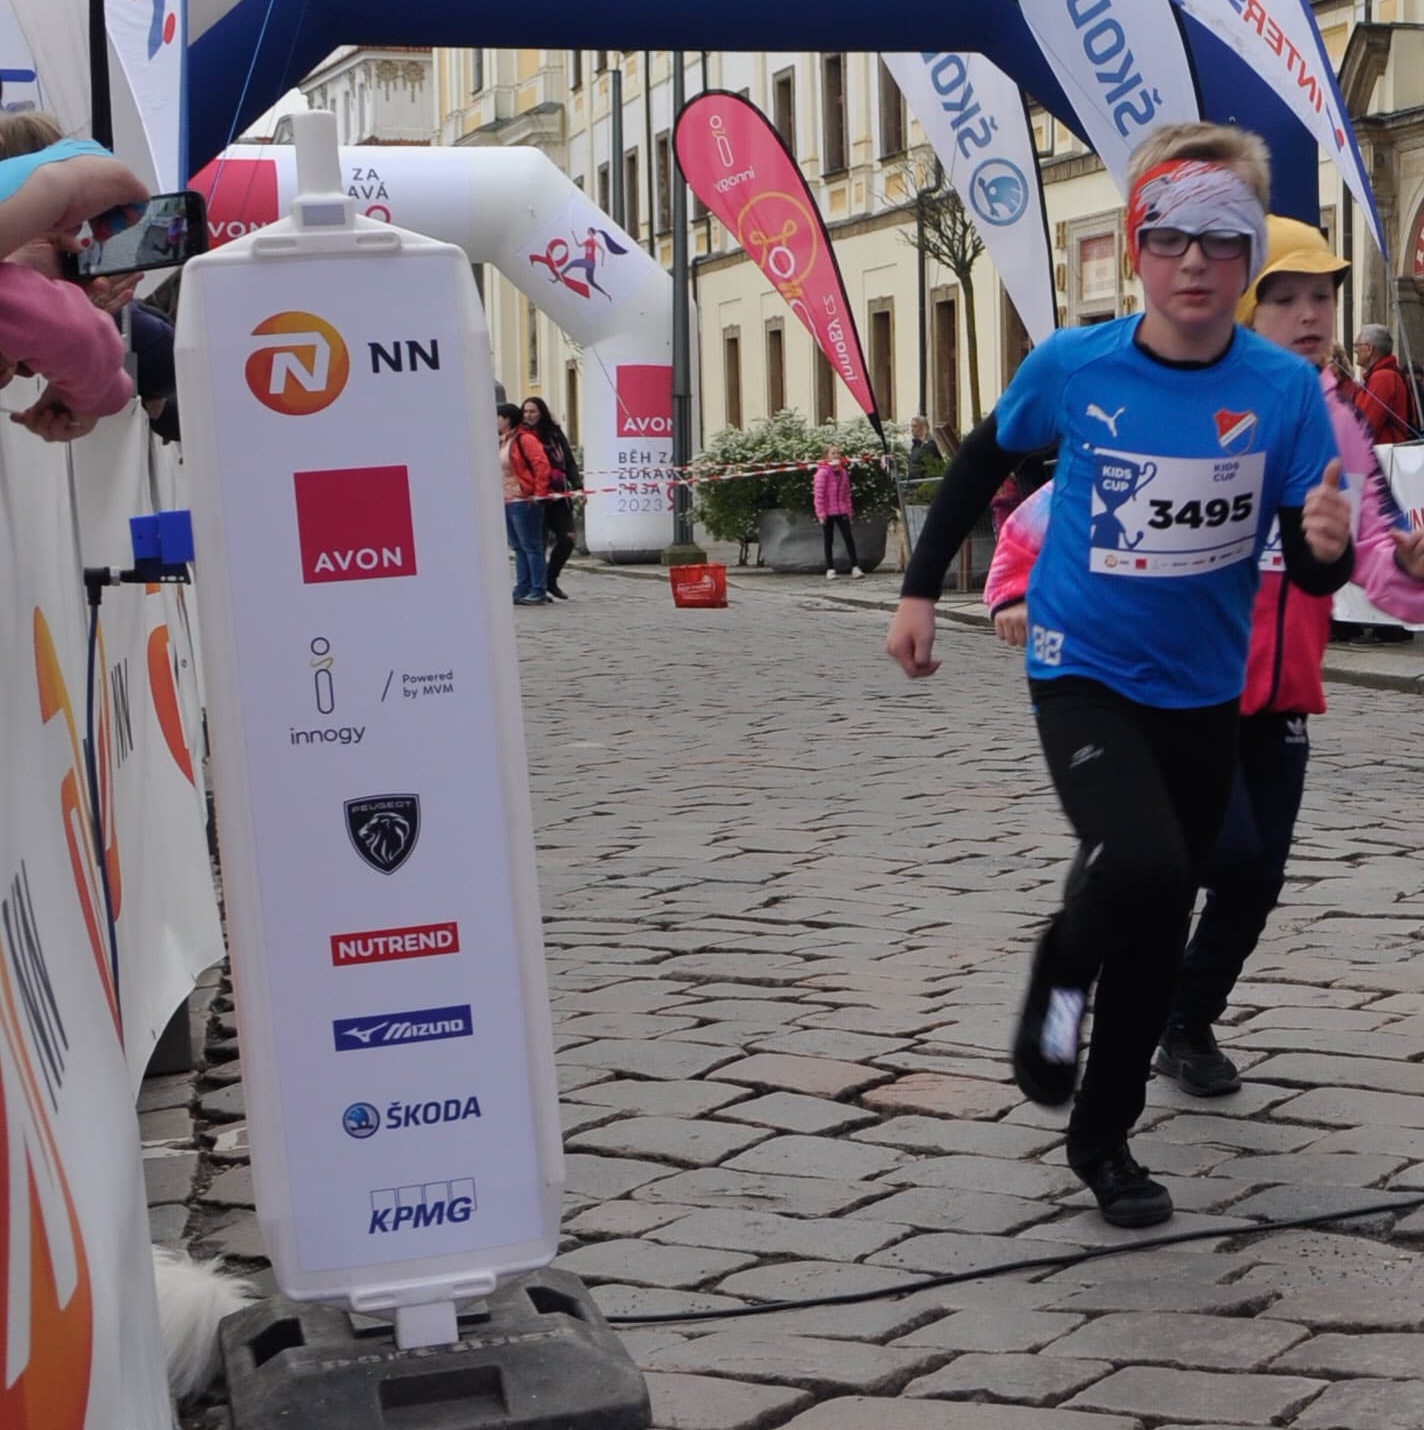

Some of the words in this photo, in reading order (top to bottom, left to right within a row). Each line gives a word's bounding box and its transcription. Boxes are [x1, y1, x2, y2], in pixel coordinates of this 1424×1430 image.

[352, 168, 380, 181] ZA
[348, 181, 389, 199] AVÁ
[208, 221, 266, 239] VON
[368, 339, 440, 374] NN
[617, 466, 676, 480] ZDRAV
[1102, 465, 1132, 479] KIDS
[1213, 462, 1240, 471] KIDS
[1102, 480, 1130, 491] CUP
[1213, 472, 1236, 482] CUP
[617, 498, 663, 513] 2023
[1147, 491, 1254, 530] 3495
[313, 546, 402, 575] AVON
[402, 669, 454, 684] Powered
[403, 686, 418, 699] by
[422, 682, 454, 696] MVM
[289, 726, 366, 746] innogy
[351, 800, 412, 814] PEUGEOT
[338, 929, 454, 959] NUTREND
[385, 1096, 482, 1131] ŠKODA
[367, 1195, 474, 1235] KPMG
